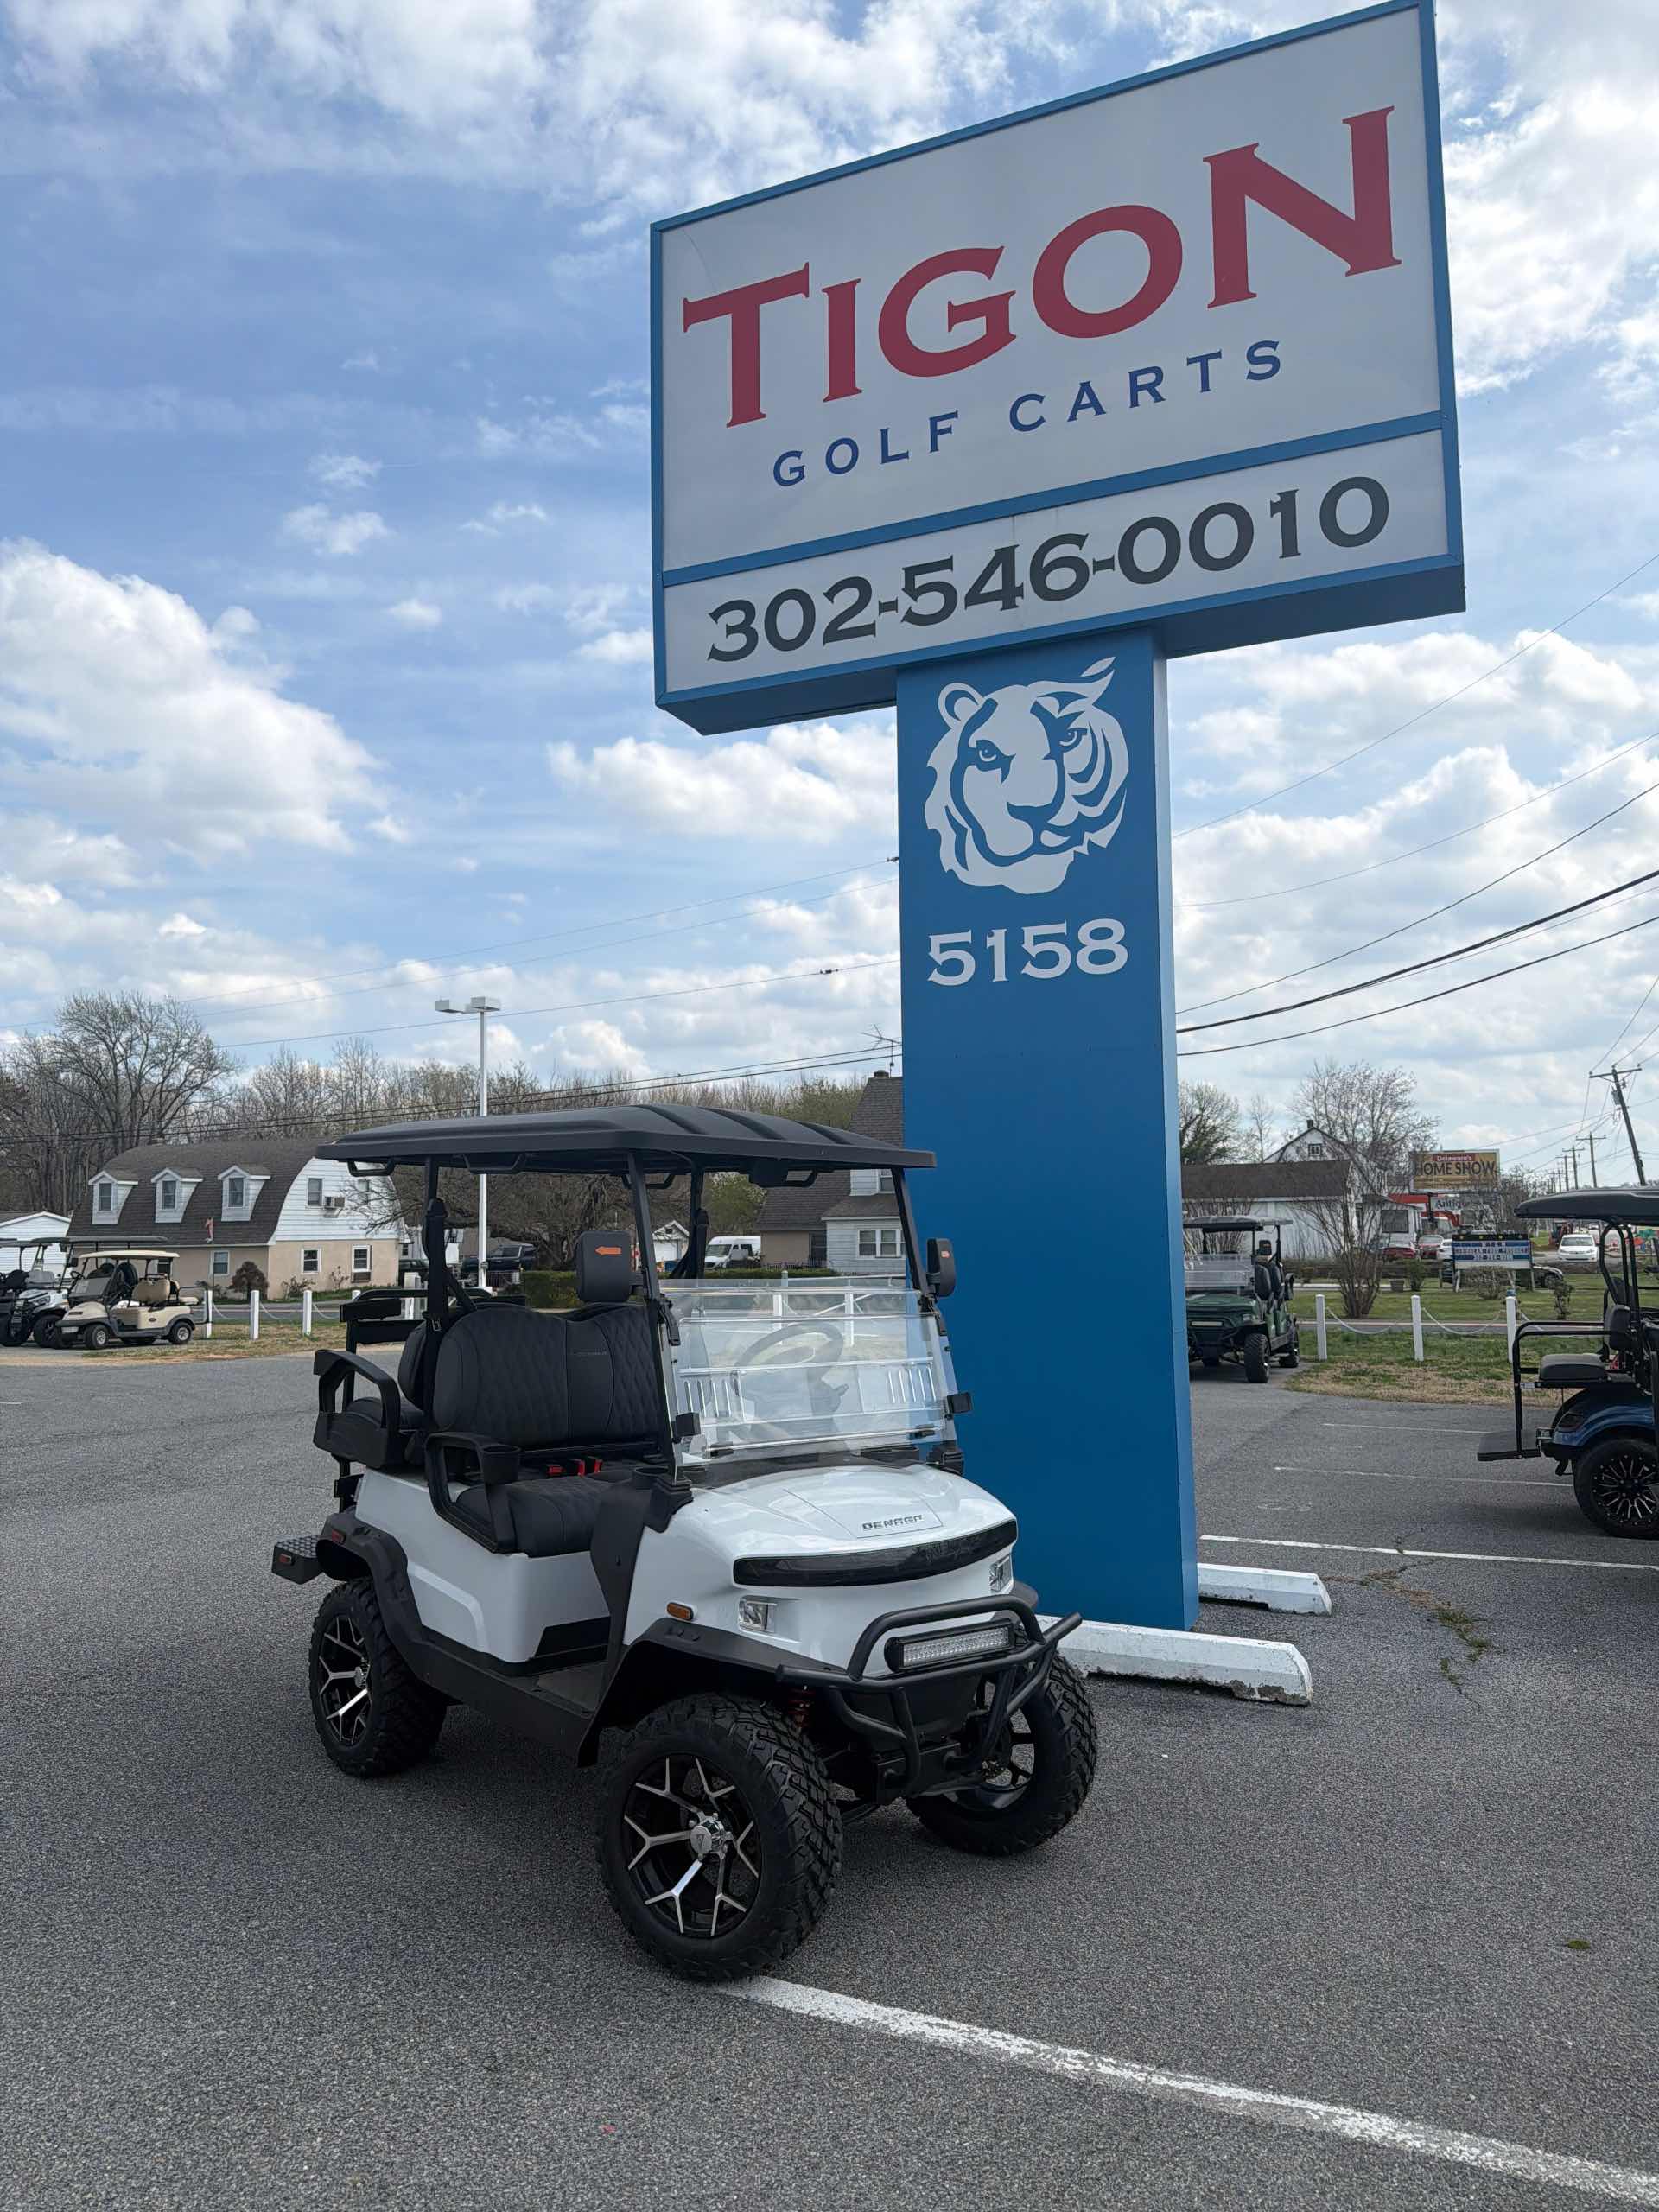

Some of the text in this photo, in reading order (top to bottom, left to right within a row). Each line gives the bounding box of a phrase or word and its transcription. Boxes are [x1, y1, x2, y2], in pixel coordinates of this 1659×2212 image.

[683, 105, 1402, 428] TIGON
[772, 340, 1282, 487] GOLF CARTS
[707, 476, 1390, 662] 302-546-0010
[927, 918, 1128, 986] 5158
[1414, 1160, 1495, 1176] HOME SHOW
